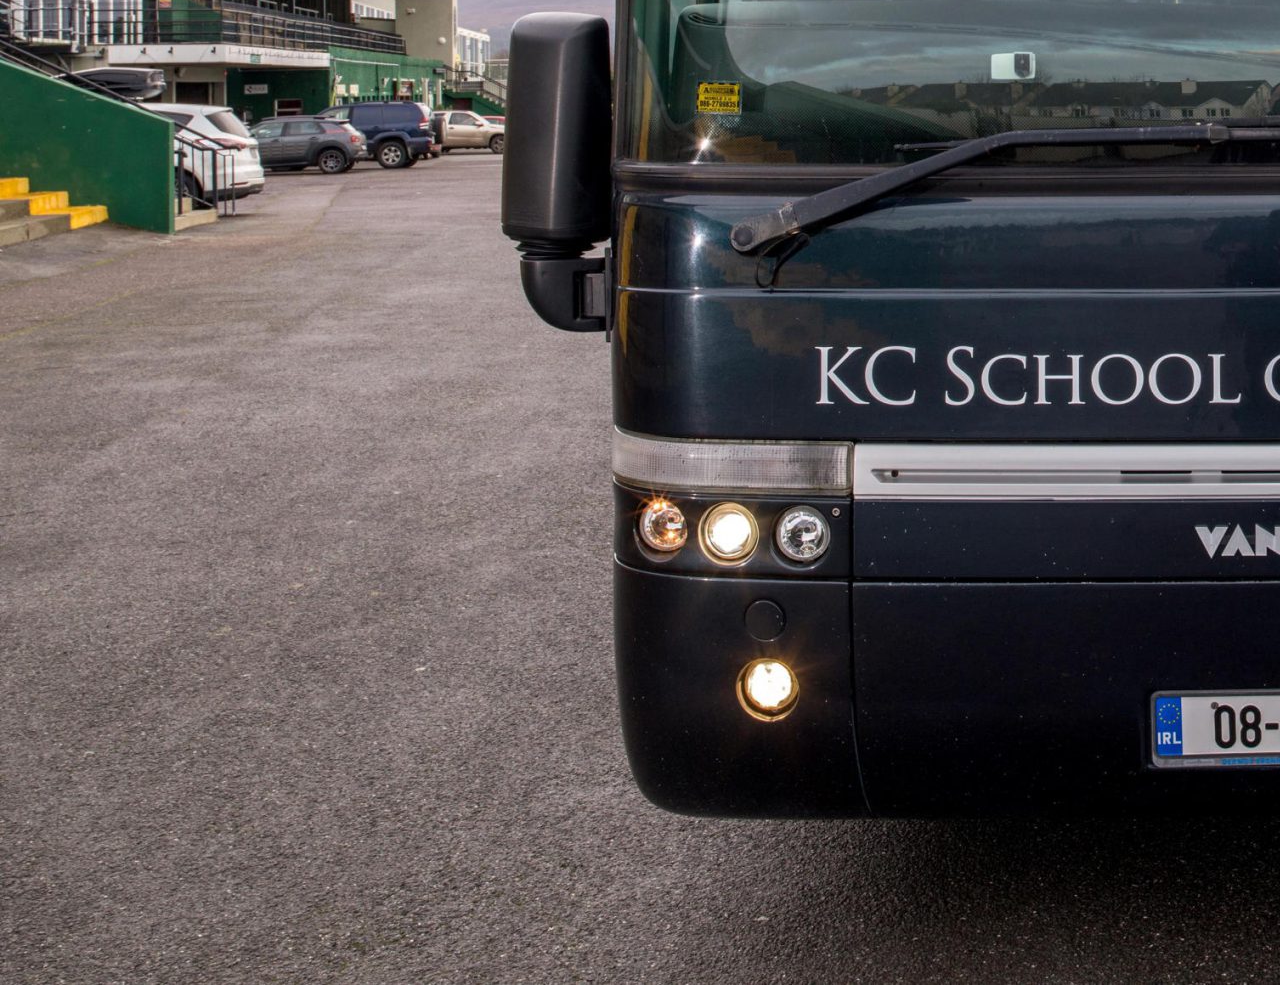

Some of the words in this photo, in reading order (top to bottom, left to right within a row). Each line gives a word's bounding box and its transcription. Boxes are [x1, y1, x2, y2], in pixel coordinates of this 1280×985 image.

[815, 345, 917, 405] KC
[944, 345, 1242, 405] SCHOOL
[1157, 732, 1182, 745] IRL
